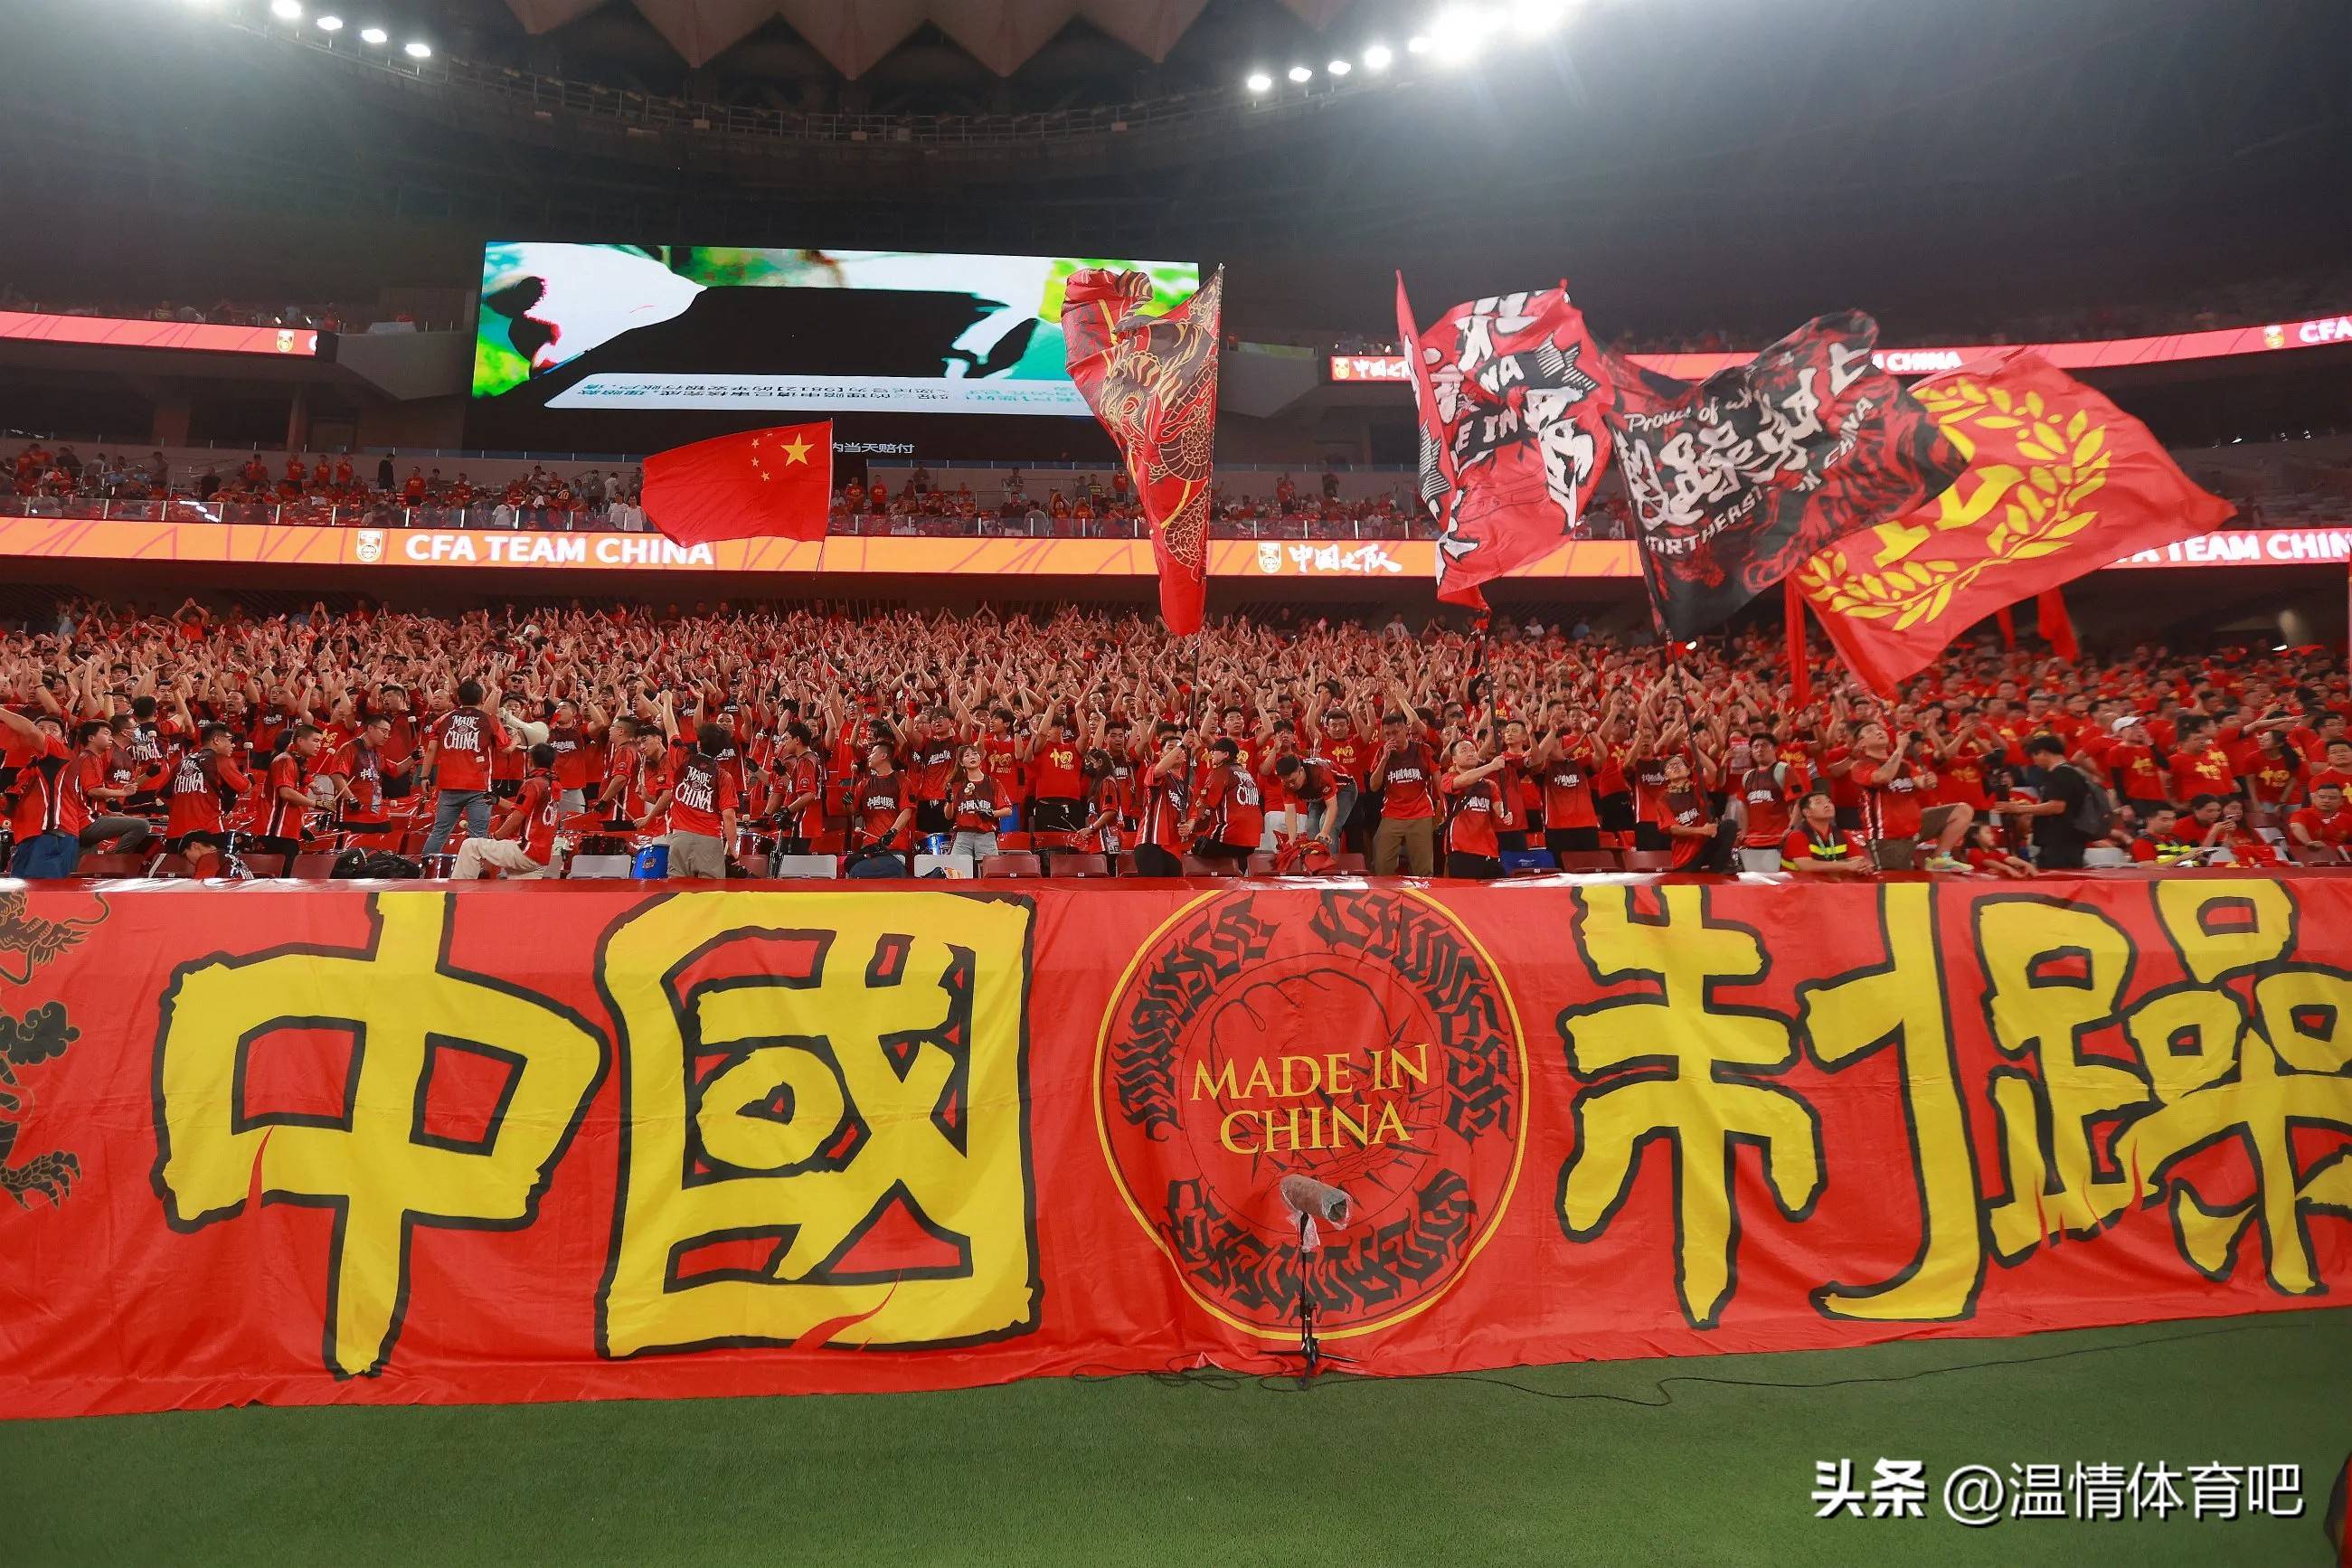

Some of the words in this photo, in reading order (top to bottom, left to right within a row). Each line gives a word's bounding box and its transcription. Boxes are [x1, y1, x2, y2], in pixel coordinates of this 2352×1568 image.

[2300, 316, 2352, 343] CFA
[1887, 351, 1962, 372] CHINA
[405, 534, 477, 562] CFA
[485, 536, 586, 563] TEAM
[595, 538, 714, 565] CHINA
[1288, 543, 1403, 572] 中国之队
[449, 715, 479, 732] MADE
[443, 730, 481, 752] CHINA
[685, 765, 713, 790] MADE
[675, 779, 714, 813] CHINA
[1189, 1053, 1354, 1102] MADE
[1371, 1044, 1431, 1090] IN
[151, 889, 1042, 1381] 中國
[1220, 1100, 1413, 1155] CHINA
